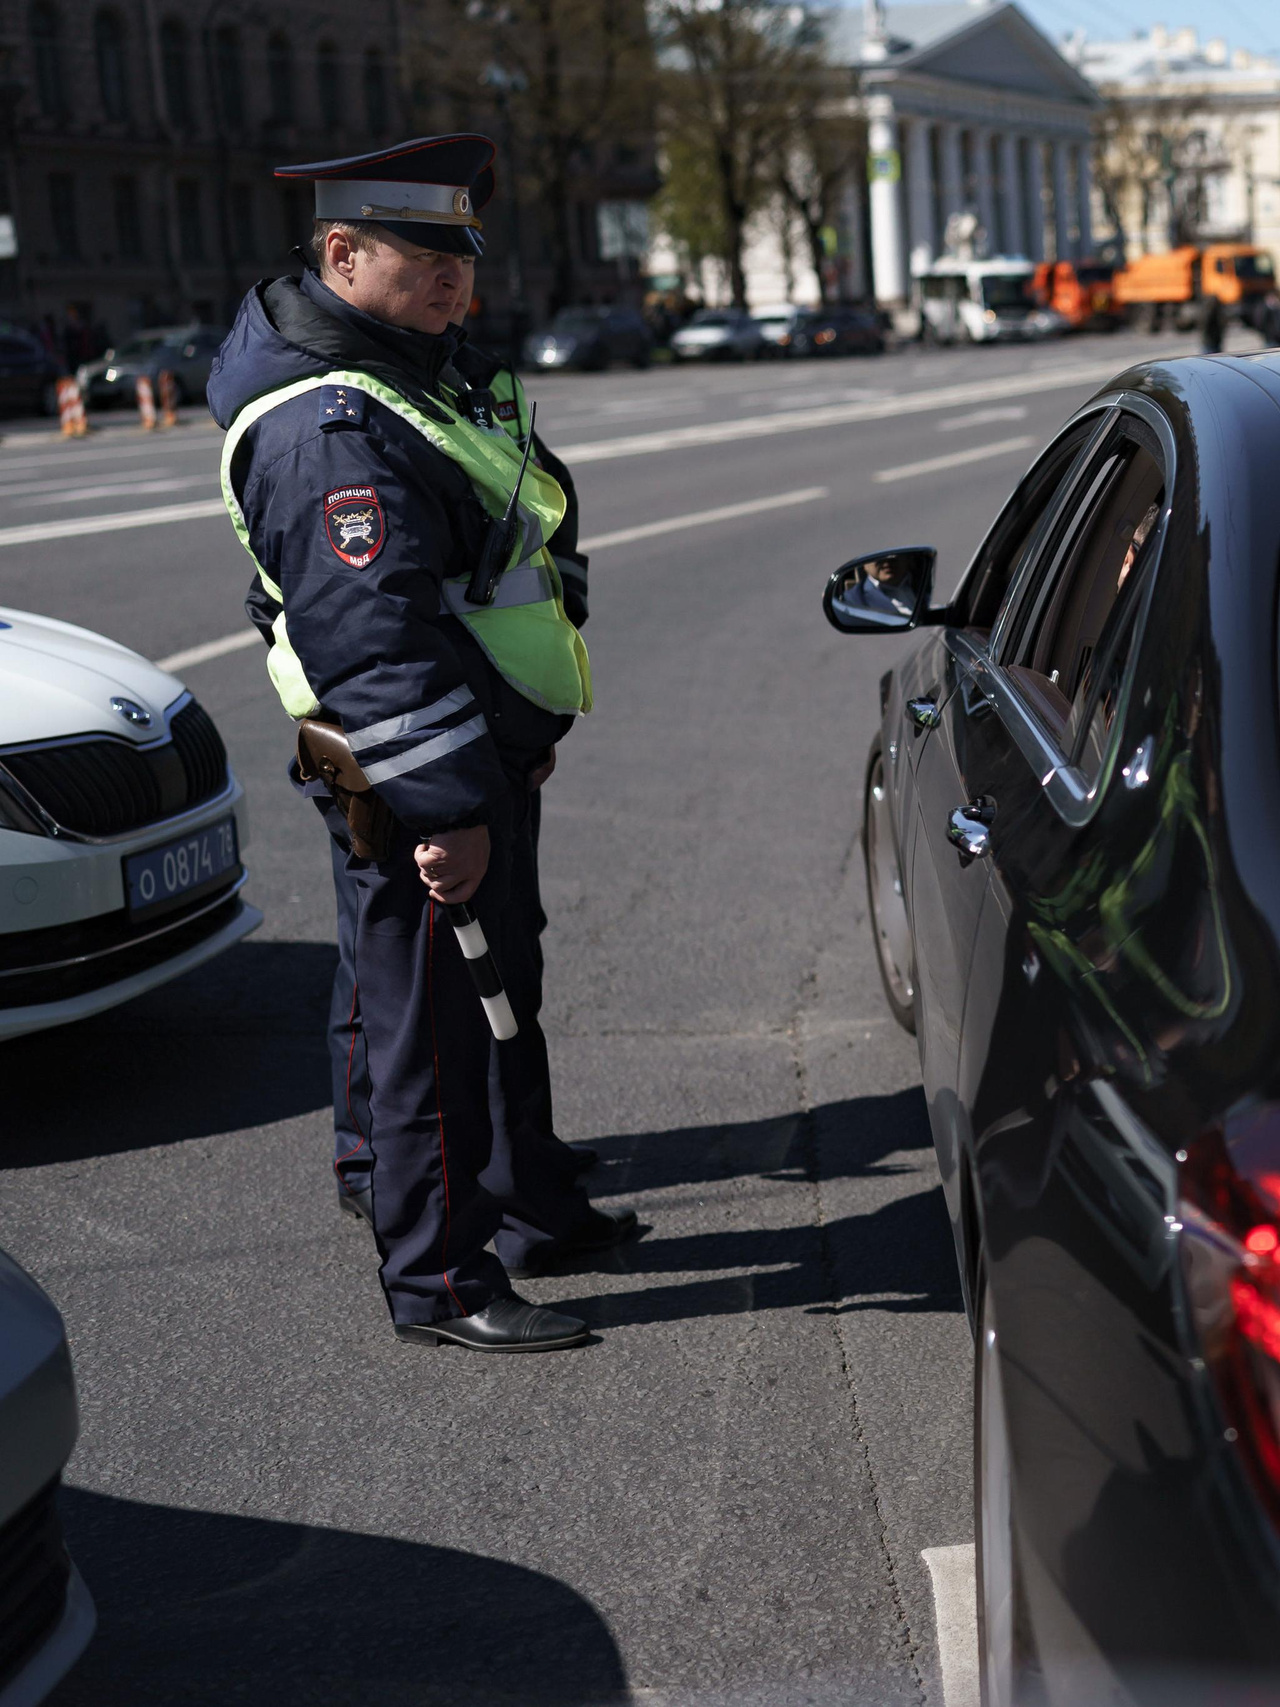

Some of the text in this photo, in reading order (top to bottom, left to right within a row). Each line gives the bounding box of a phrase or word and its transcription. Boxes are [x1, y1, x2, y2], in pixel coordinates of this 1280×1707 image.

[327, 488, 372, 504] ПОЛИЦИЯ
[349, 553, 370, 567] МВД
[163, 836, 213, 892] 0874
